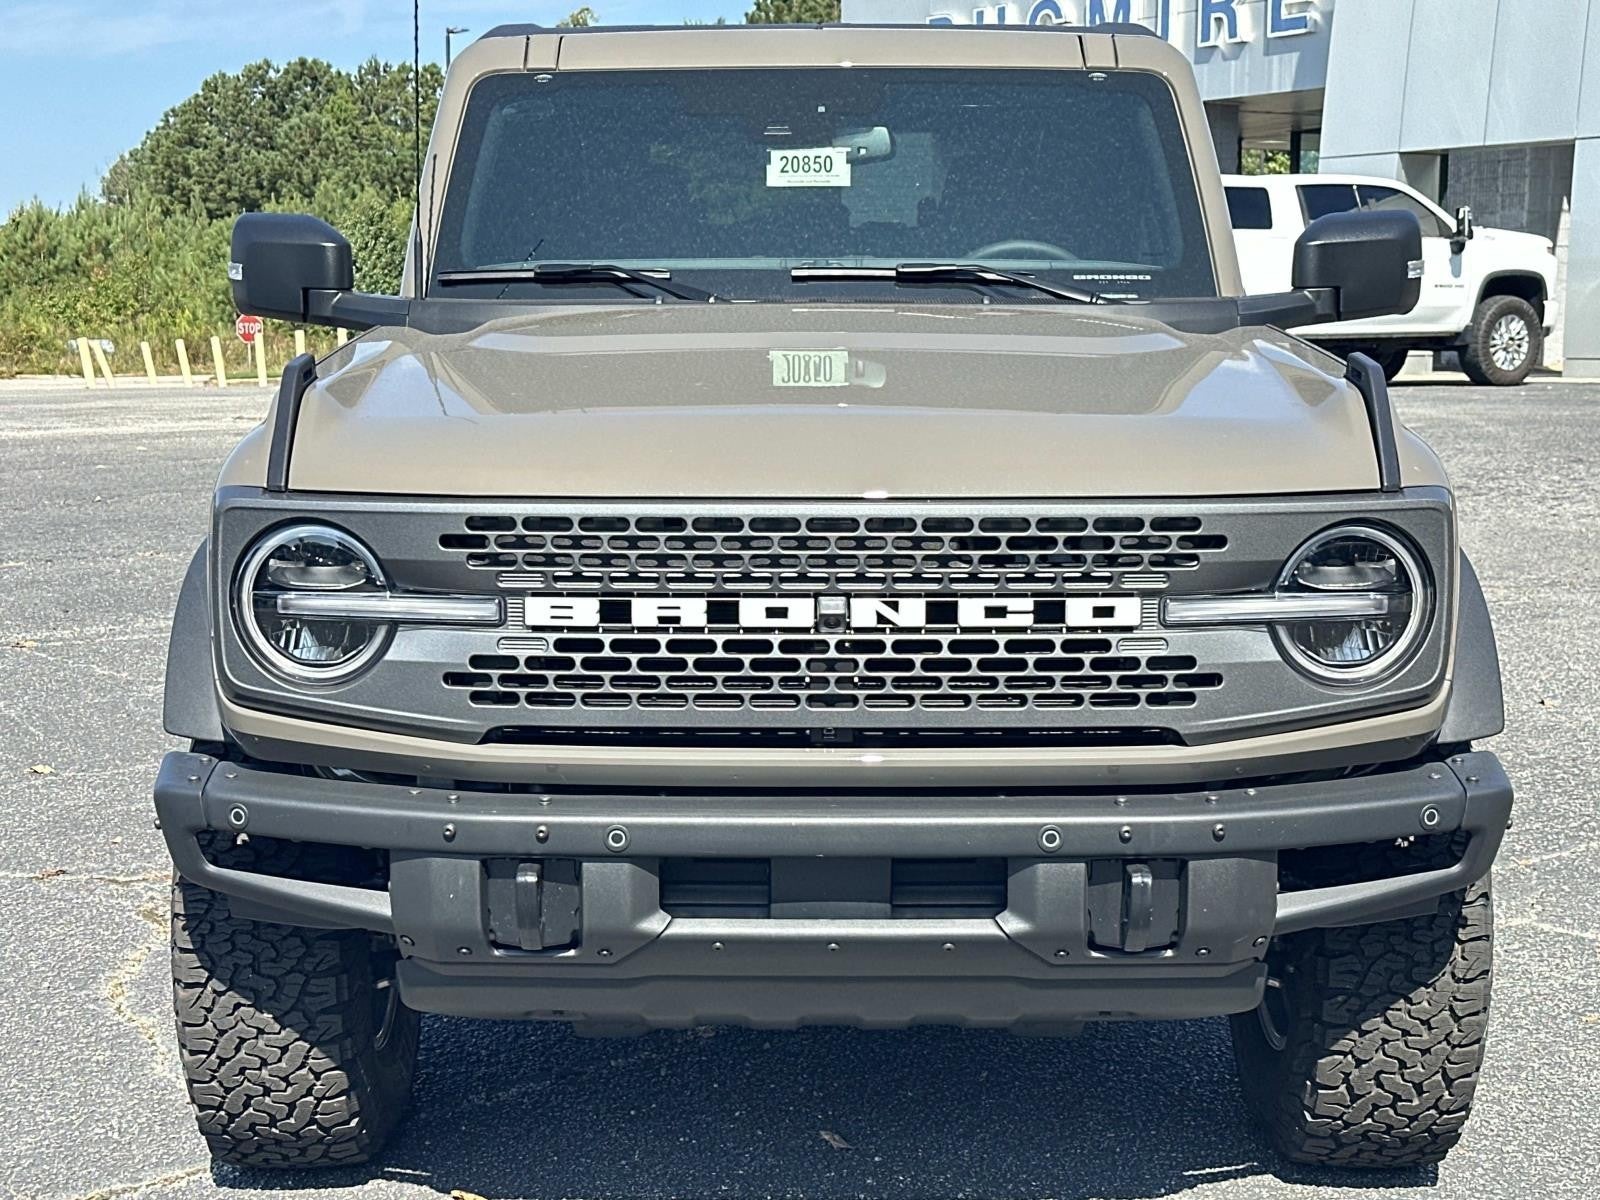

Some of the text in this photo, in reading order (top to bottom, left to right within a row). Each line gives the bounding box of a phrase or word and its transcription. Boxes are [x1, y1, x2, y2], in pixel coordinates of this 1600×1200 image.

[780, 155, 833, 173] 20850
[238, 322, 261, 334] STOP
[525, 597, 1141, 627] BRONCO
